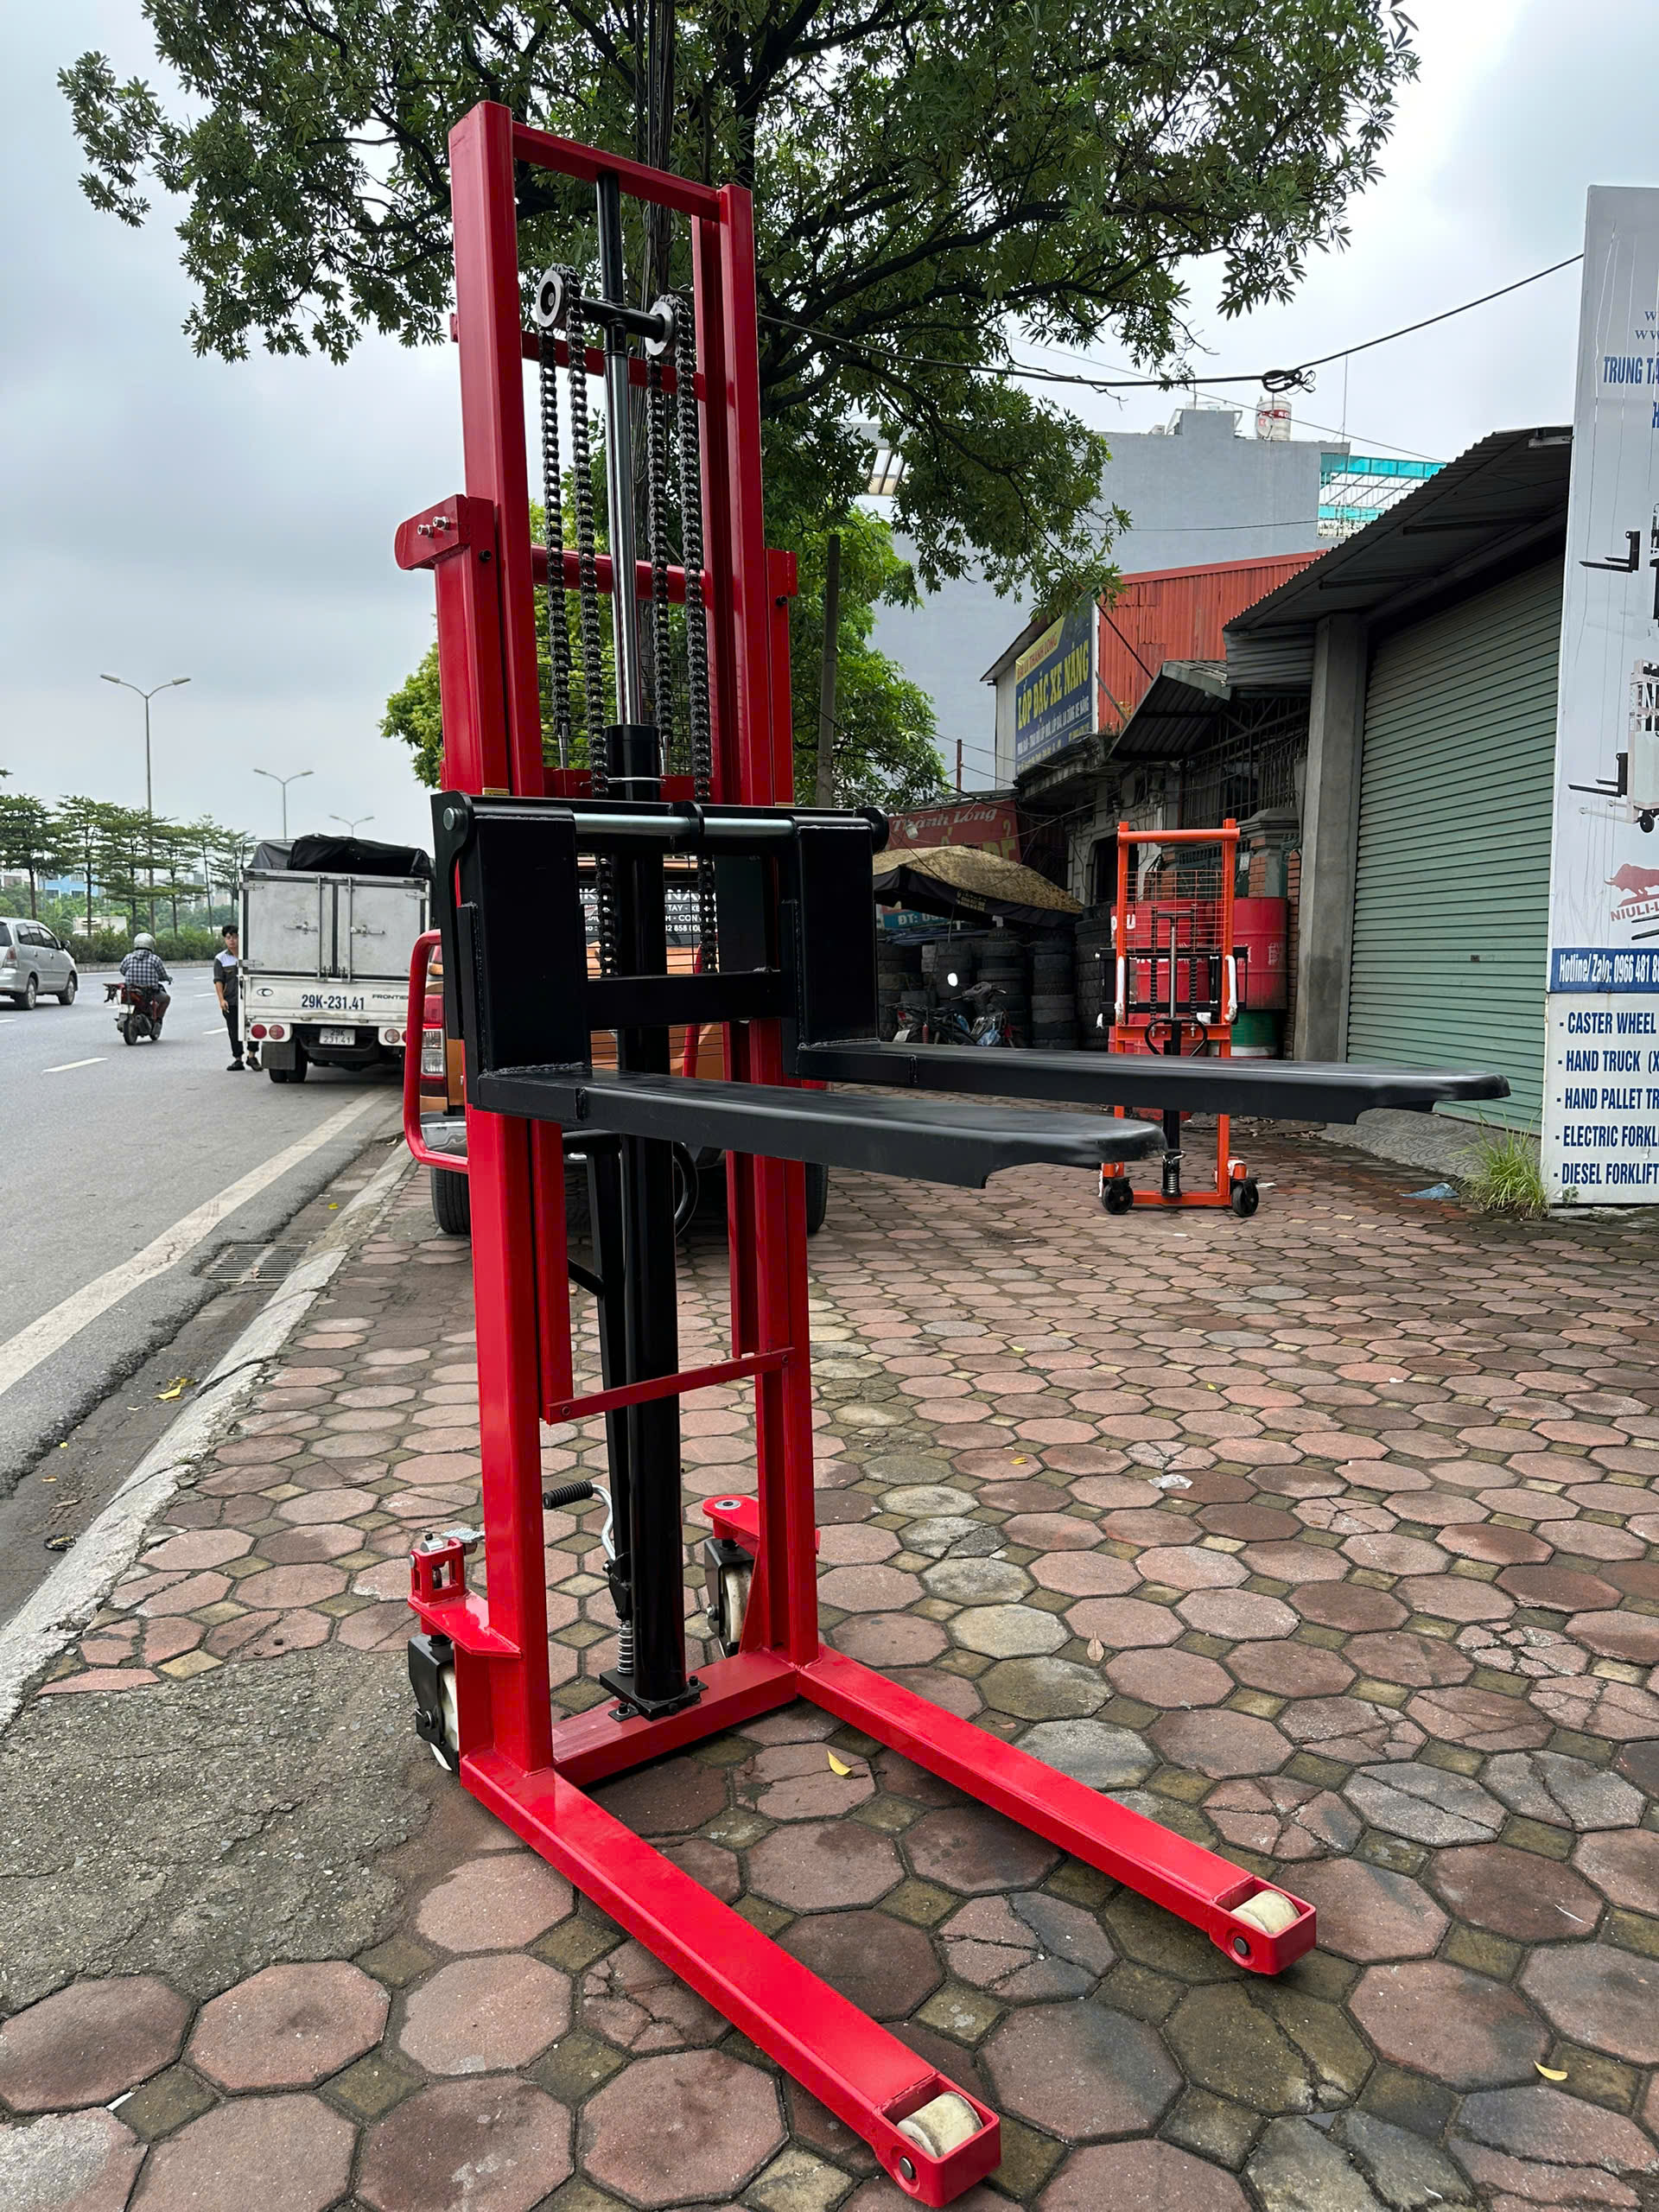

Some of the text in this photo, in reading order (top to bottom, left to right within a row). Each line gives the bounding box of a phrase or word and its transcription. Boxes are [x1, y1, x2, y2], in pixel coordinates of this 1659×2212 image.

[1604, 356, 1643, 384] TRUNG
[1050, 661, 1063, 707] XE
[1559, 953, 1592, 982] Hotline/
[1614, 954, 1633, 983] 0966
[1636, 954, 1649, 983] 481
[1652, 954, 1659, 983] 8
[302, 995, 365, 1010] 29K-231.41
[1567, 1012, 1656, 1034] CASTER WHEEL
[1566, 1050, 1599, 1072] HAND
[1603, 1050, 1640, 1072] TRUCK
[1565, 1088, 1599, 1109] HAND
[1601, 1088, 1643, 1109] PALLET
[1563, 1125, 1659, 1147] ELECTRIC FORKL
[1561, 1163, 1659, 1185] DIESEL FORKLIFT
